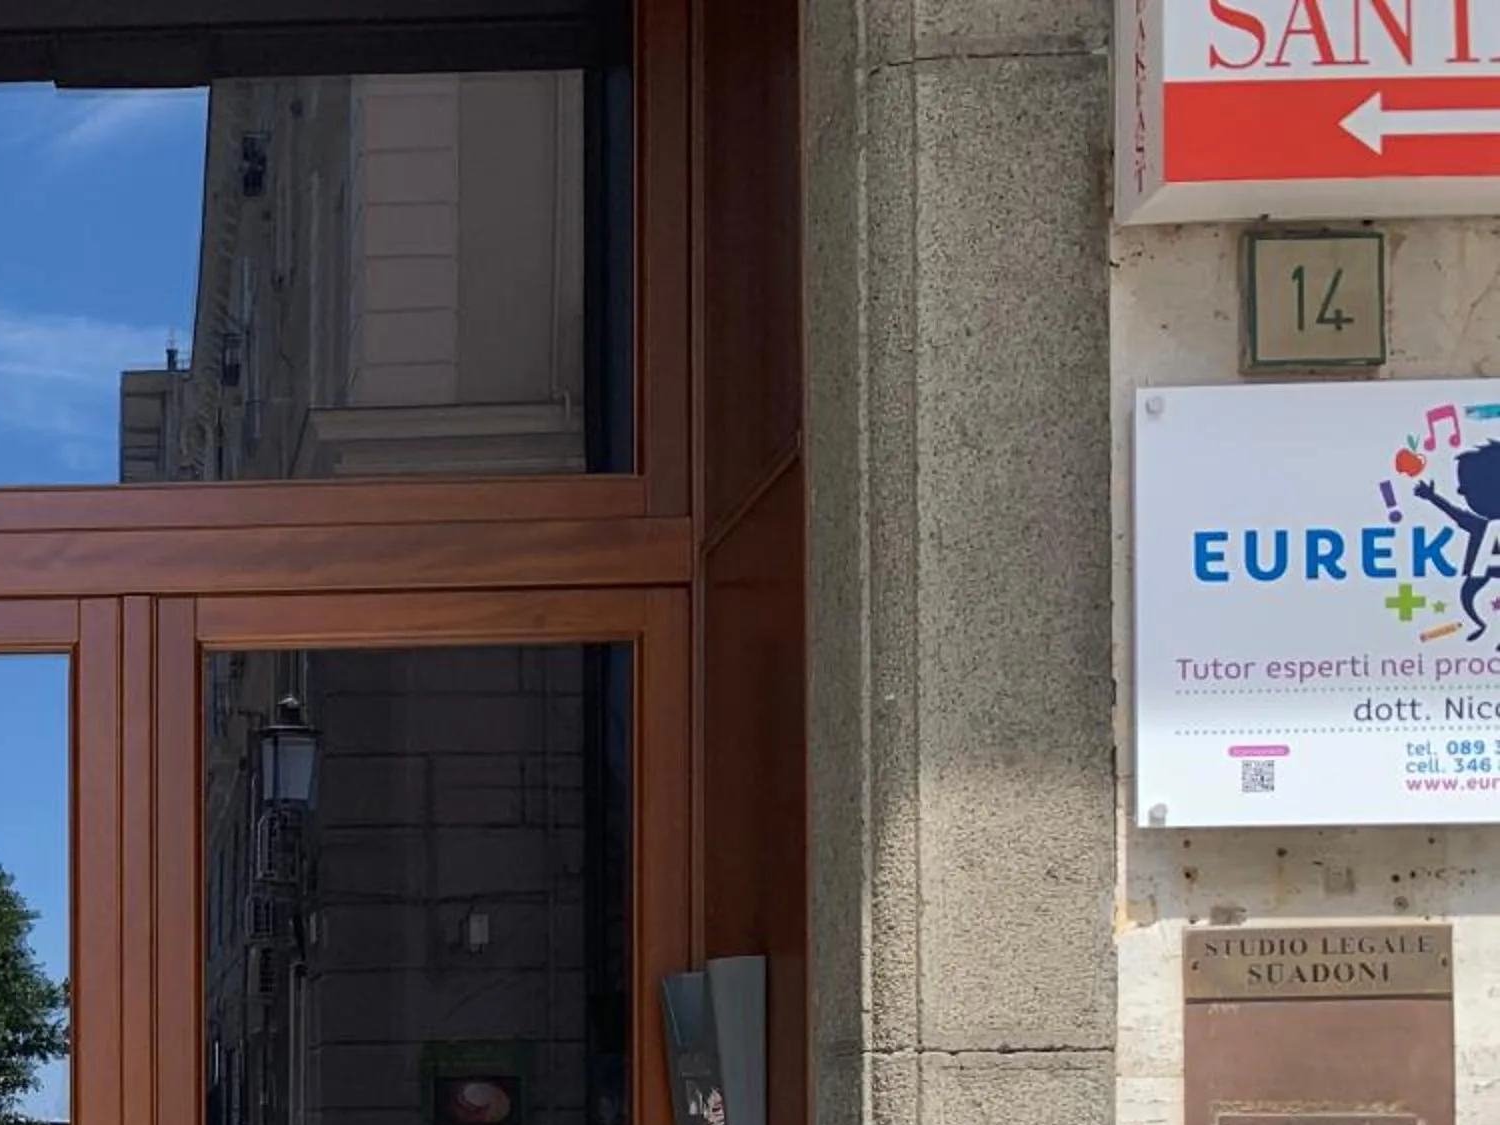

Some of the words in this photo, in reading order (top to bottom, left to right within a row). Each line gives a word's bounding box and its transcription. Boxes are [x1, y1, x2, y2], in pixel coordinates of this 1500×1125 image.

[1291, 265, 1353, 332] 14
[1176, 657, 1255, 681] Tutor
[1266, 653, 1369, 683] esperti
[1381, 653, 1423, 676] nei
[1353, 697, 1431, 722] dott.
[1406, 740, 1438, 757] tel.
[1446, 739, 1485, 755] 089
[1405, 757, 1446, 774] cell.
[1453, 756, 1492, 773] 346
[1204, 938, 1308, 958] STUDIO
[1321, 934, 1435, 955] LEGALE
[1247, 961, 1389, 984] SUADONI
